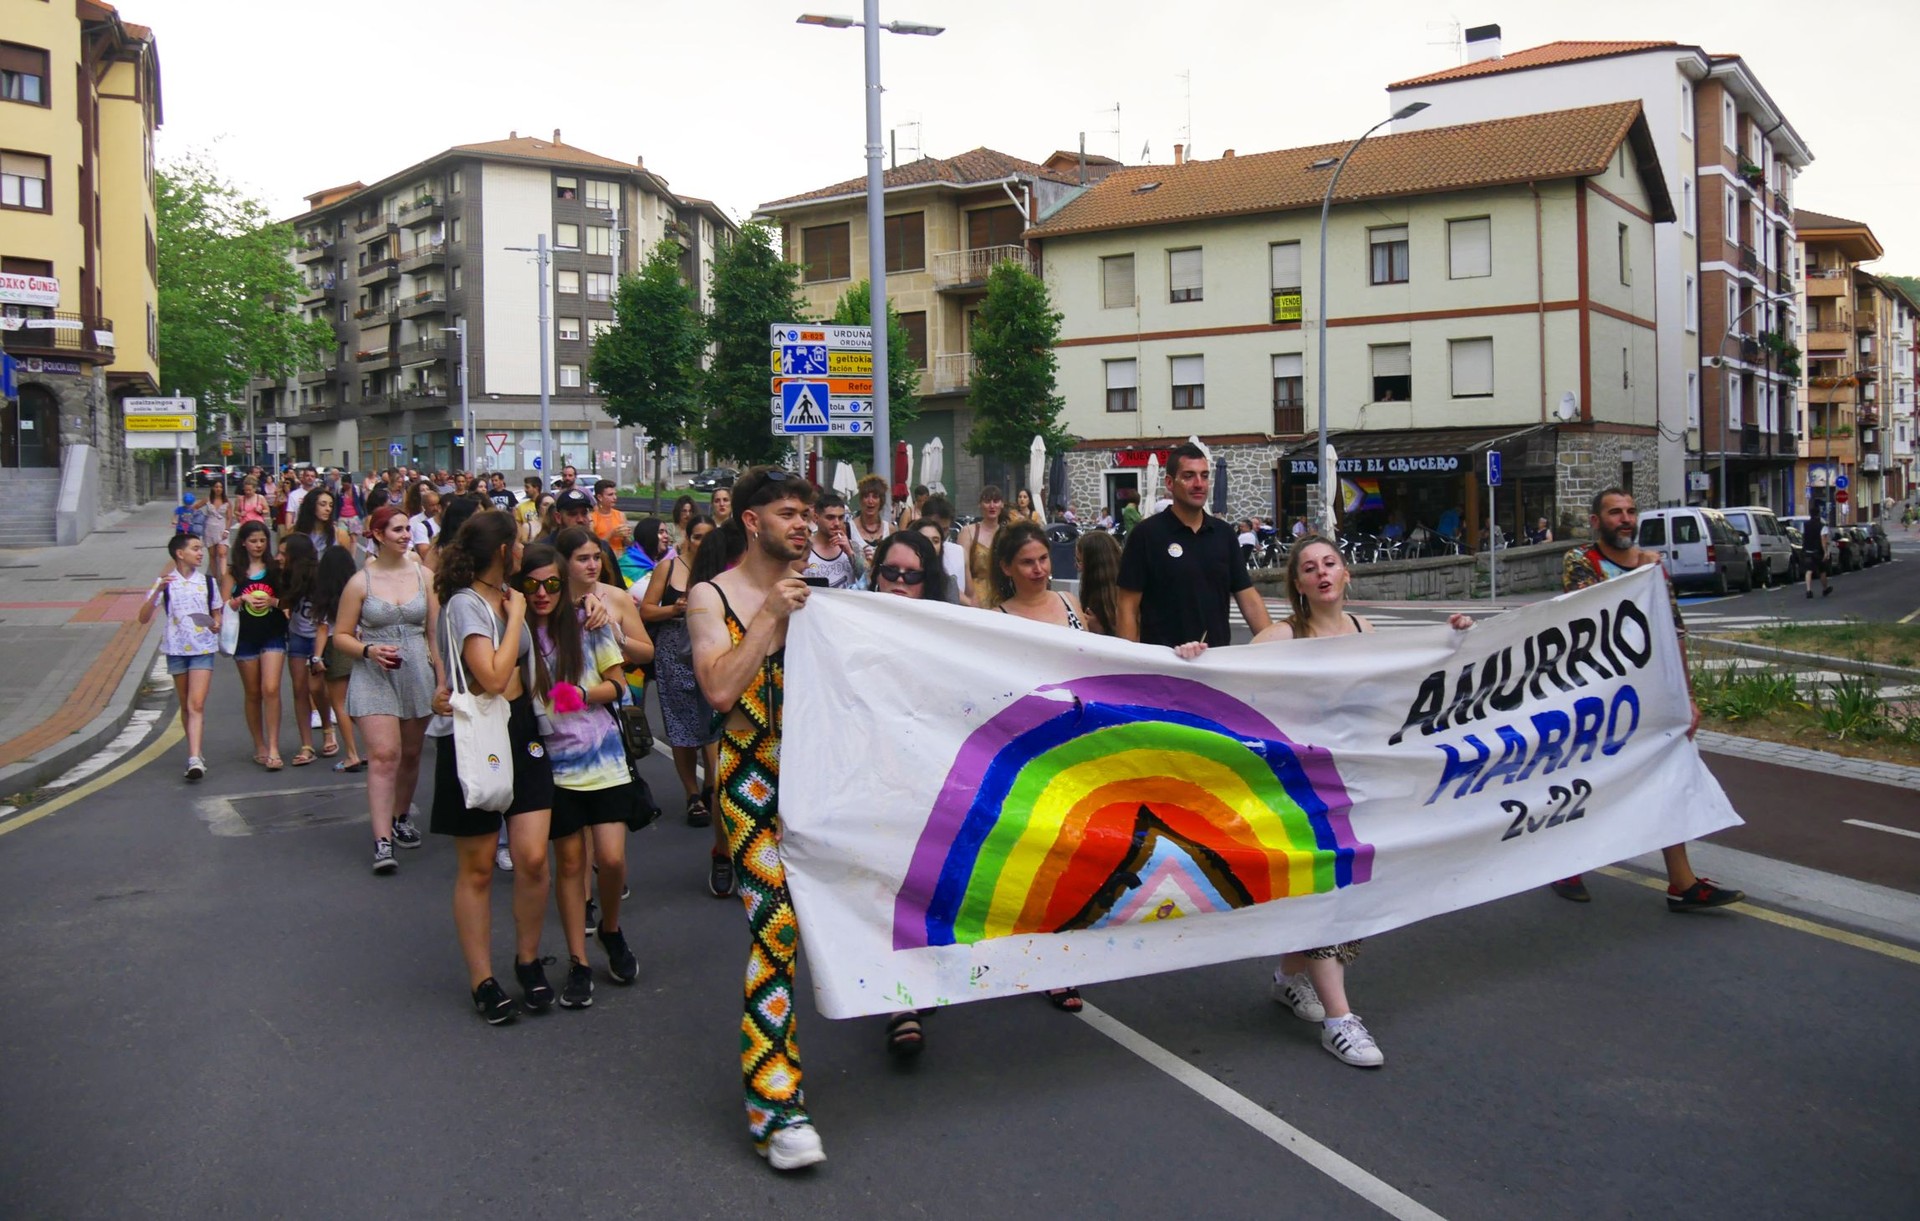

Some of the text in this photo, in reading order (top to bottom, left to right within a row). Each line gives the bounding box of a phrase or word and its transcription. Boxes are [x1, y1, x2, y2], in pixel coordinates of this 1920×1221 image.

[1281, 297, 1300, 306] VENDE
[833, 329, 872, 338] URDUÑA
[836, 355, 872, 364] geltokia
[1127, 450, 1151, 460] NUEV
[1291, 457, 1458, 474] BAR AFE EL CRUCERO
[1387, 599, 1652, 746] AMURRIO
[1423, 684, 1641, 807] HARRO
